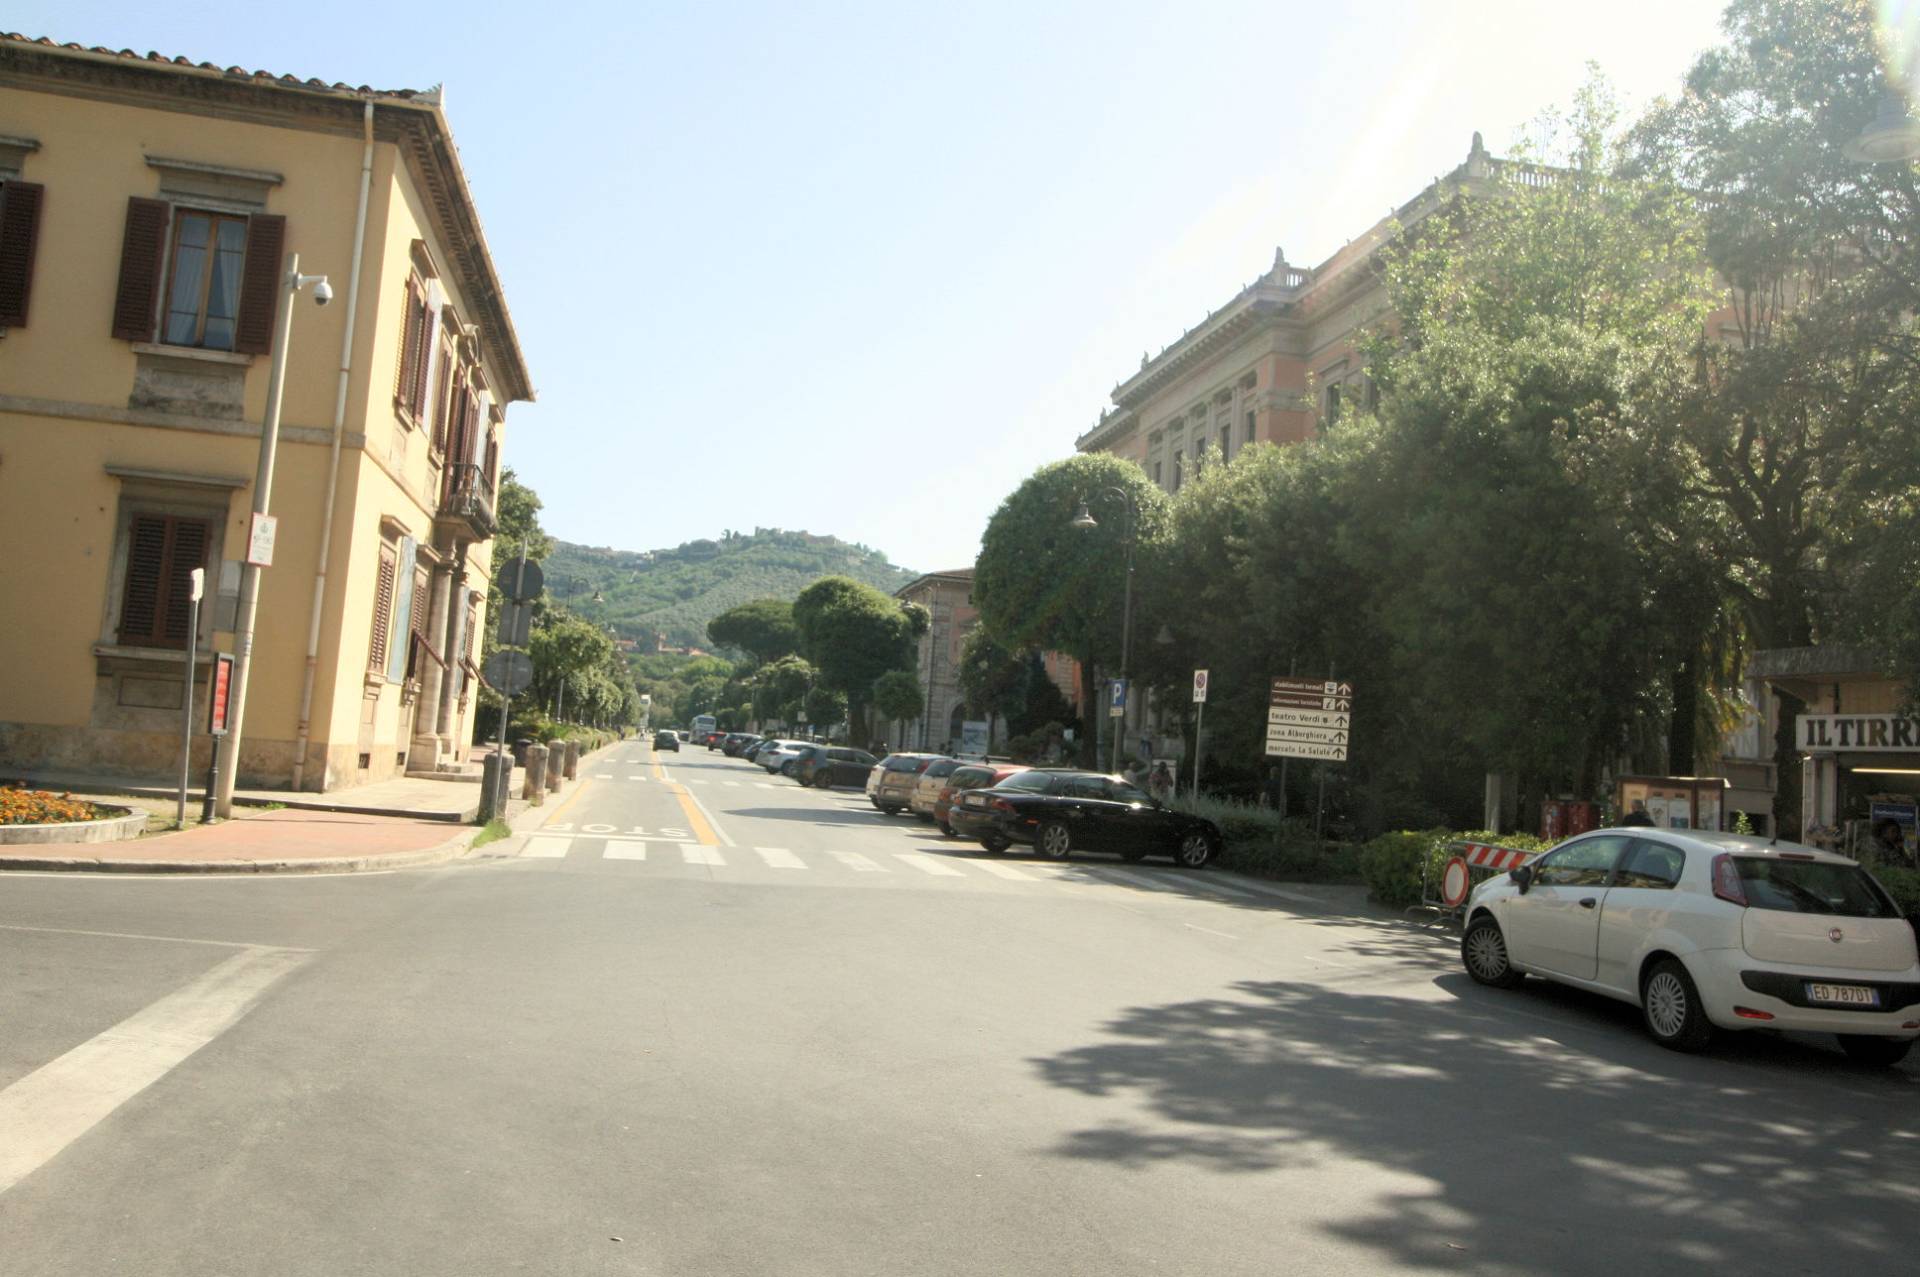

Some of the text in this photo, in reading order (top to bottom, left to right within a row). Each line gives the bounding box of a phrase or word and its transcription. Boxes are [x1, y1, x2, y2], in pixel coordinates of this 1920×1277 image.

[1113, 683, 1122, 704] P
[1271, 712, 1320, 723] teatro Verdi
[1834, 719, 1920, 747] TIRR
[542, 822, 689, 838] STOP
